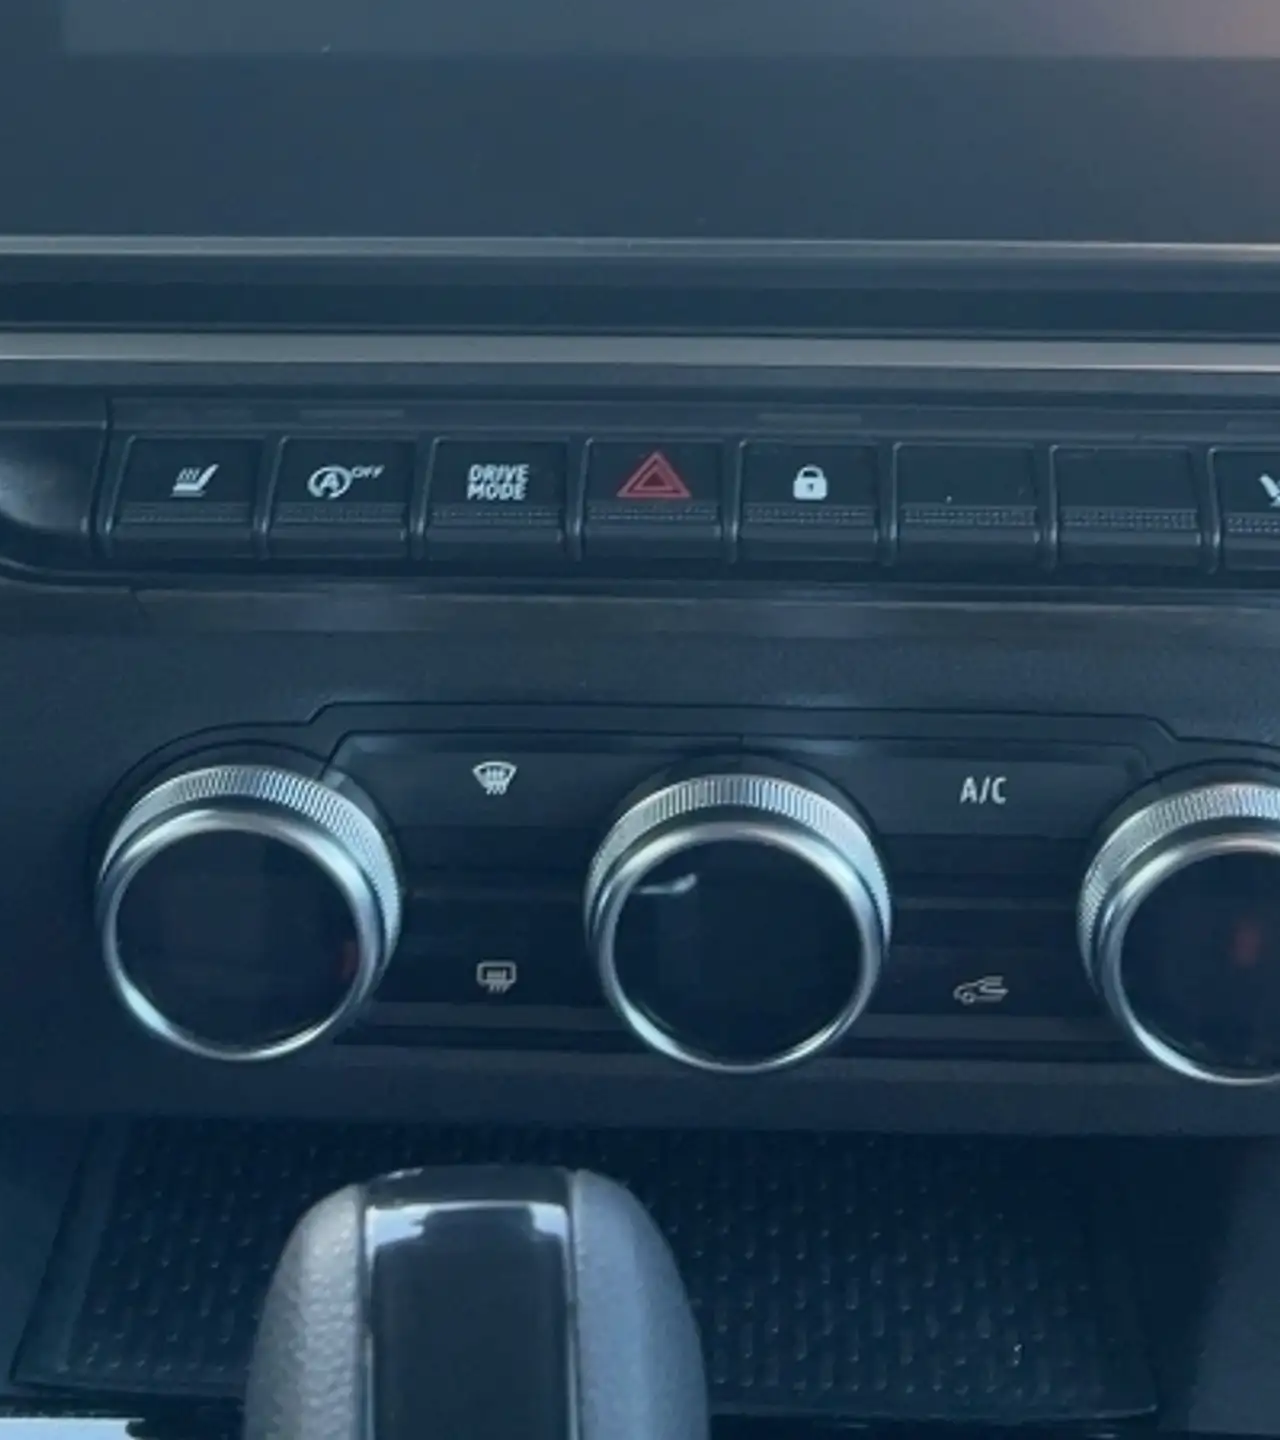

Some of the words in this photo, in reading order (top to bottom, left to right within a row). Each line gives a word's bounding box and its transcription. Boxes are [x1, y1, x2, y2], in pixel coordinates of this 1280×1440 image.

[351, 465, 384, 479] OFF
[468, 464, 529, 482] DRIVE
[467, 482, 525, 500] MODE
[960, 776, 1007, 804] A/C
